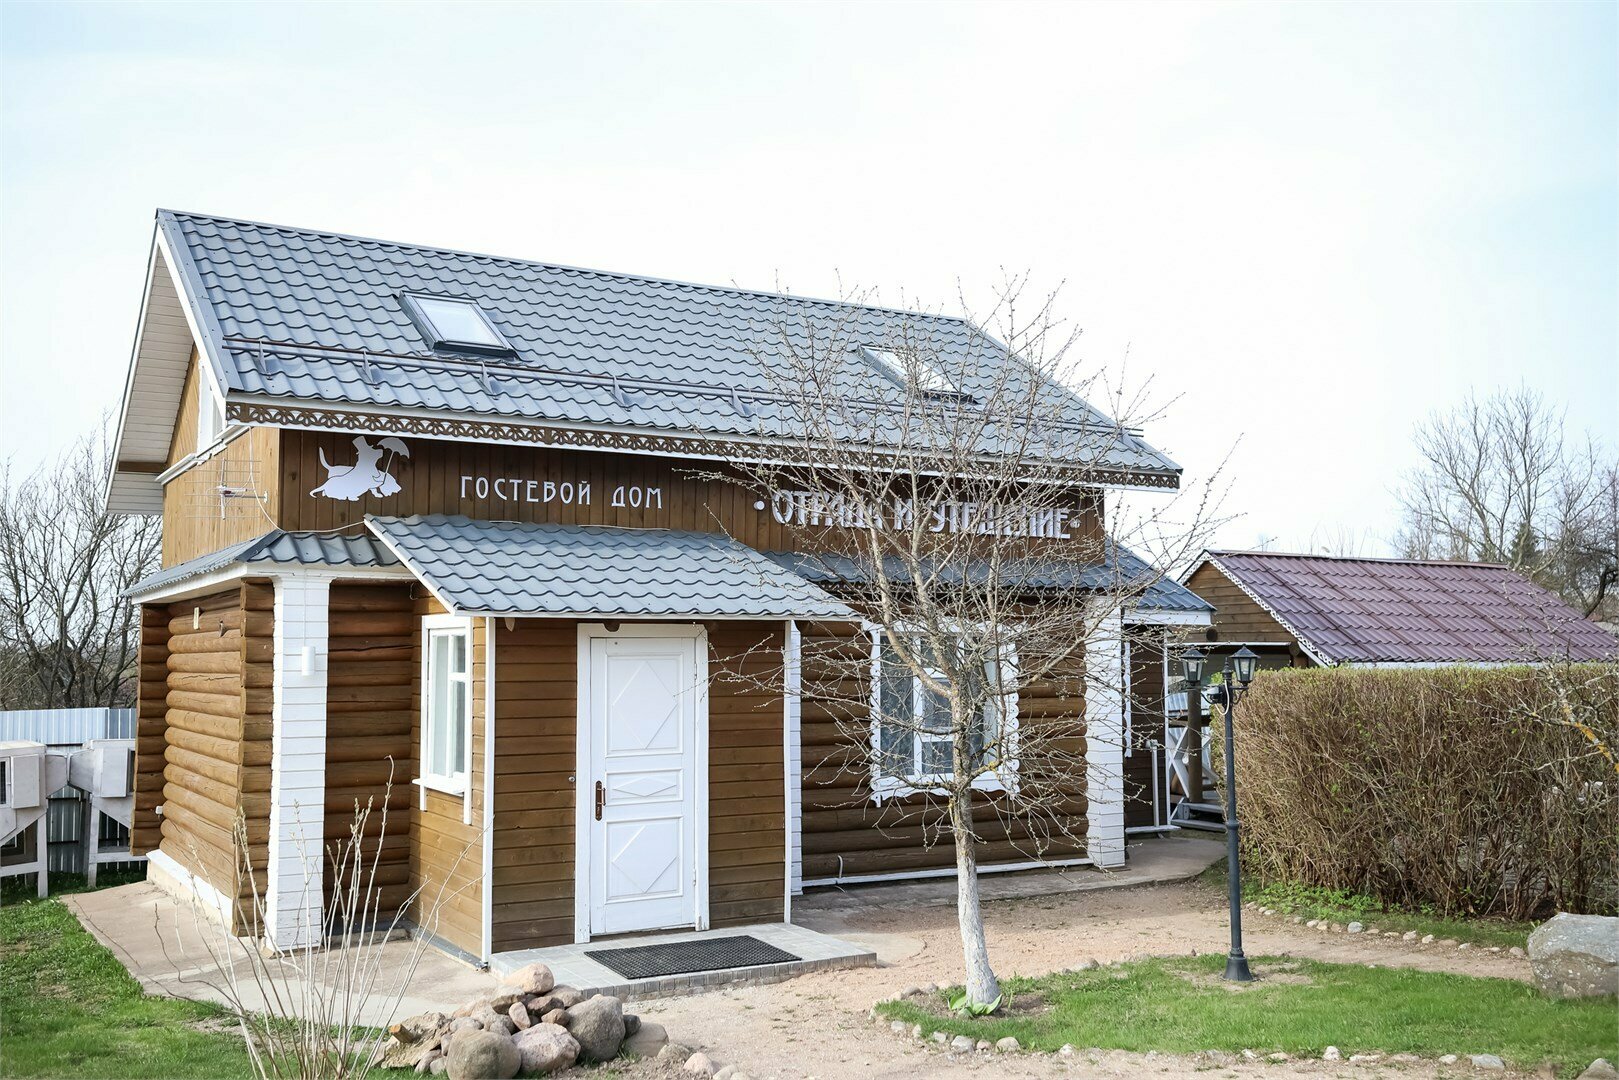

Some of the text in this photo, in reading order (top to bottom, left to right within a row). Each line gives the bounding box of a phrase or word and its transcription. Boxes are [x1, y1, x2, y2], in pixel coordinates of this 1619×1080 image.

[460, 475, 663, 509] ГОСТЕВОЙ ДОМ
[893, 498, 913, 531] И
